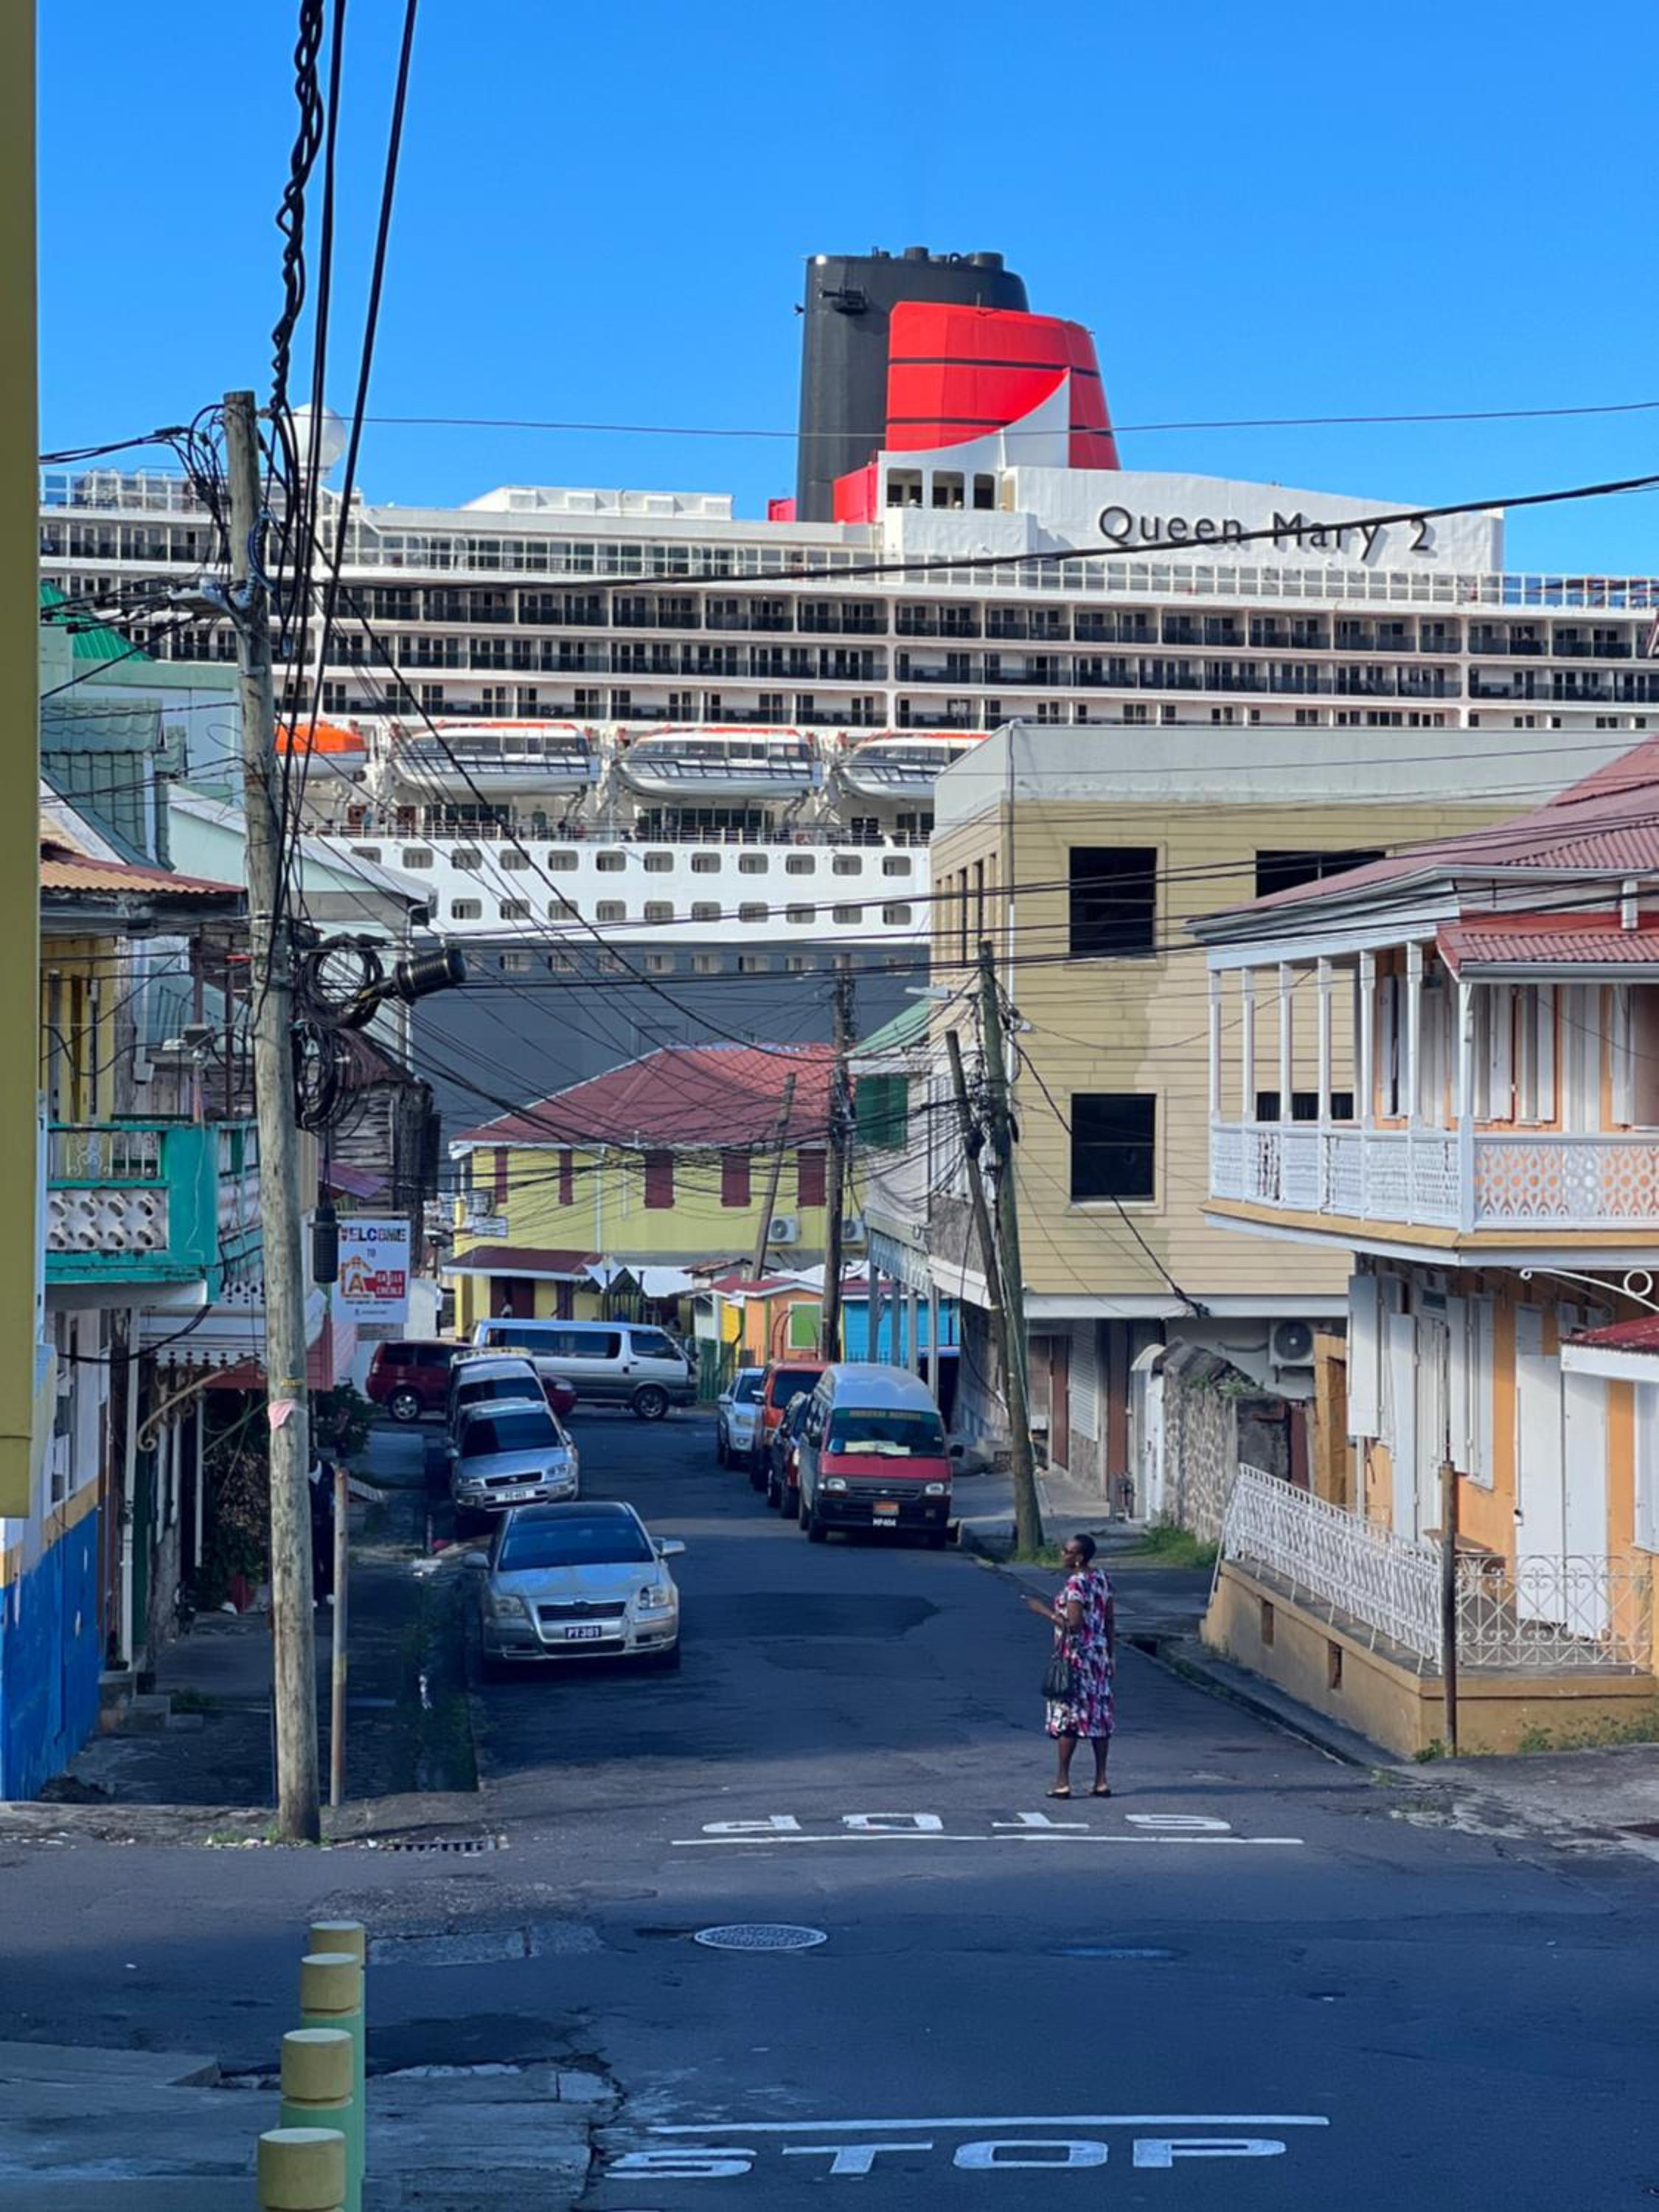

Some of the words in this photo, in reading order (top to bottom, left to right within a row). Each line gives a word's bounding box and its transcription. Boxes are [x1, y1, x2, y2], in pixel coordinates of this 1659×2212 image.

[1099, 505, 1242, 546] Queen
[1272, 511, 1383, 560] Mary
[1410, 518, 1435, 551] 2
[701, 1812, 1232, 1833] STOP
[604, 2138, 1287, 2179] STOP
